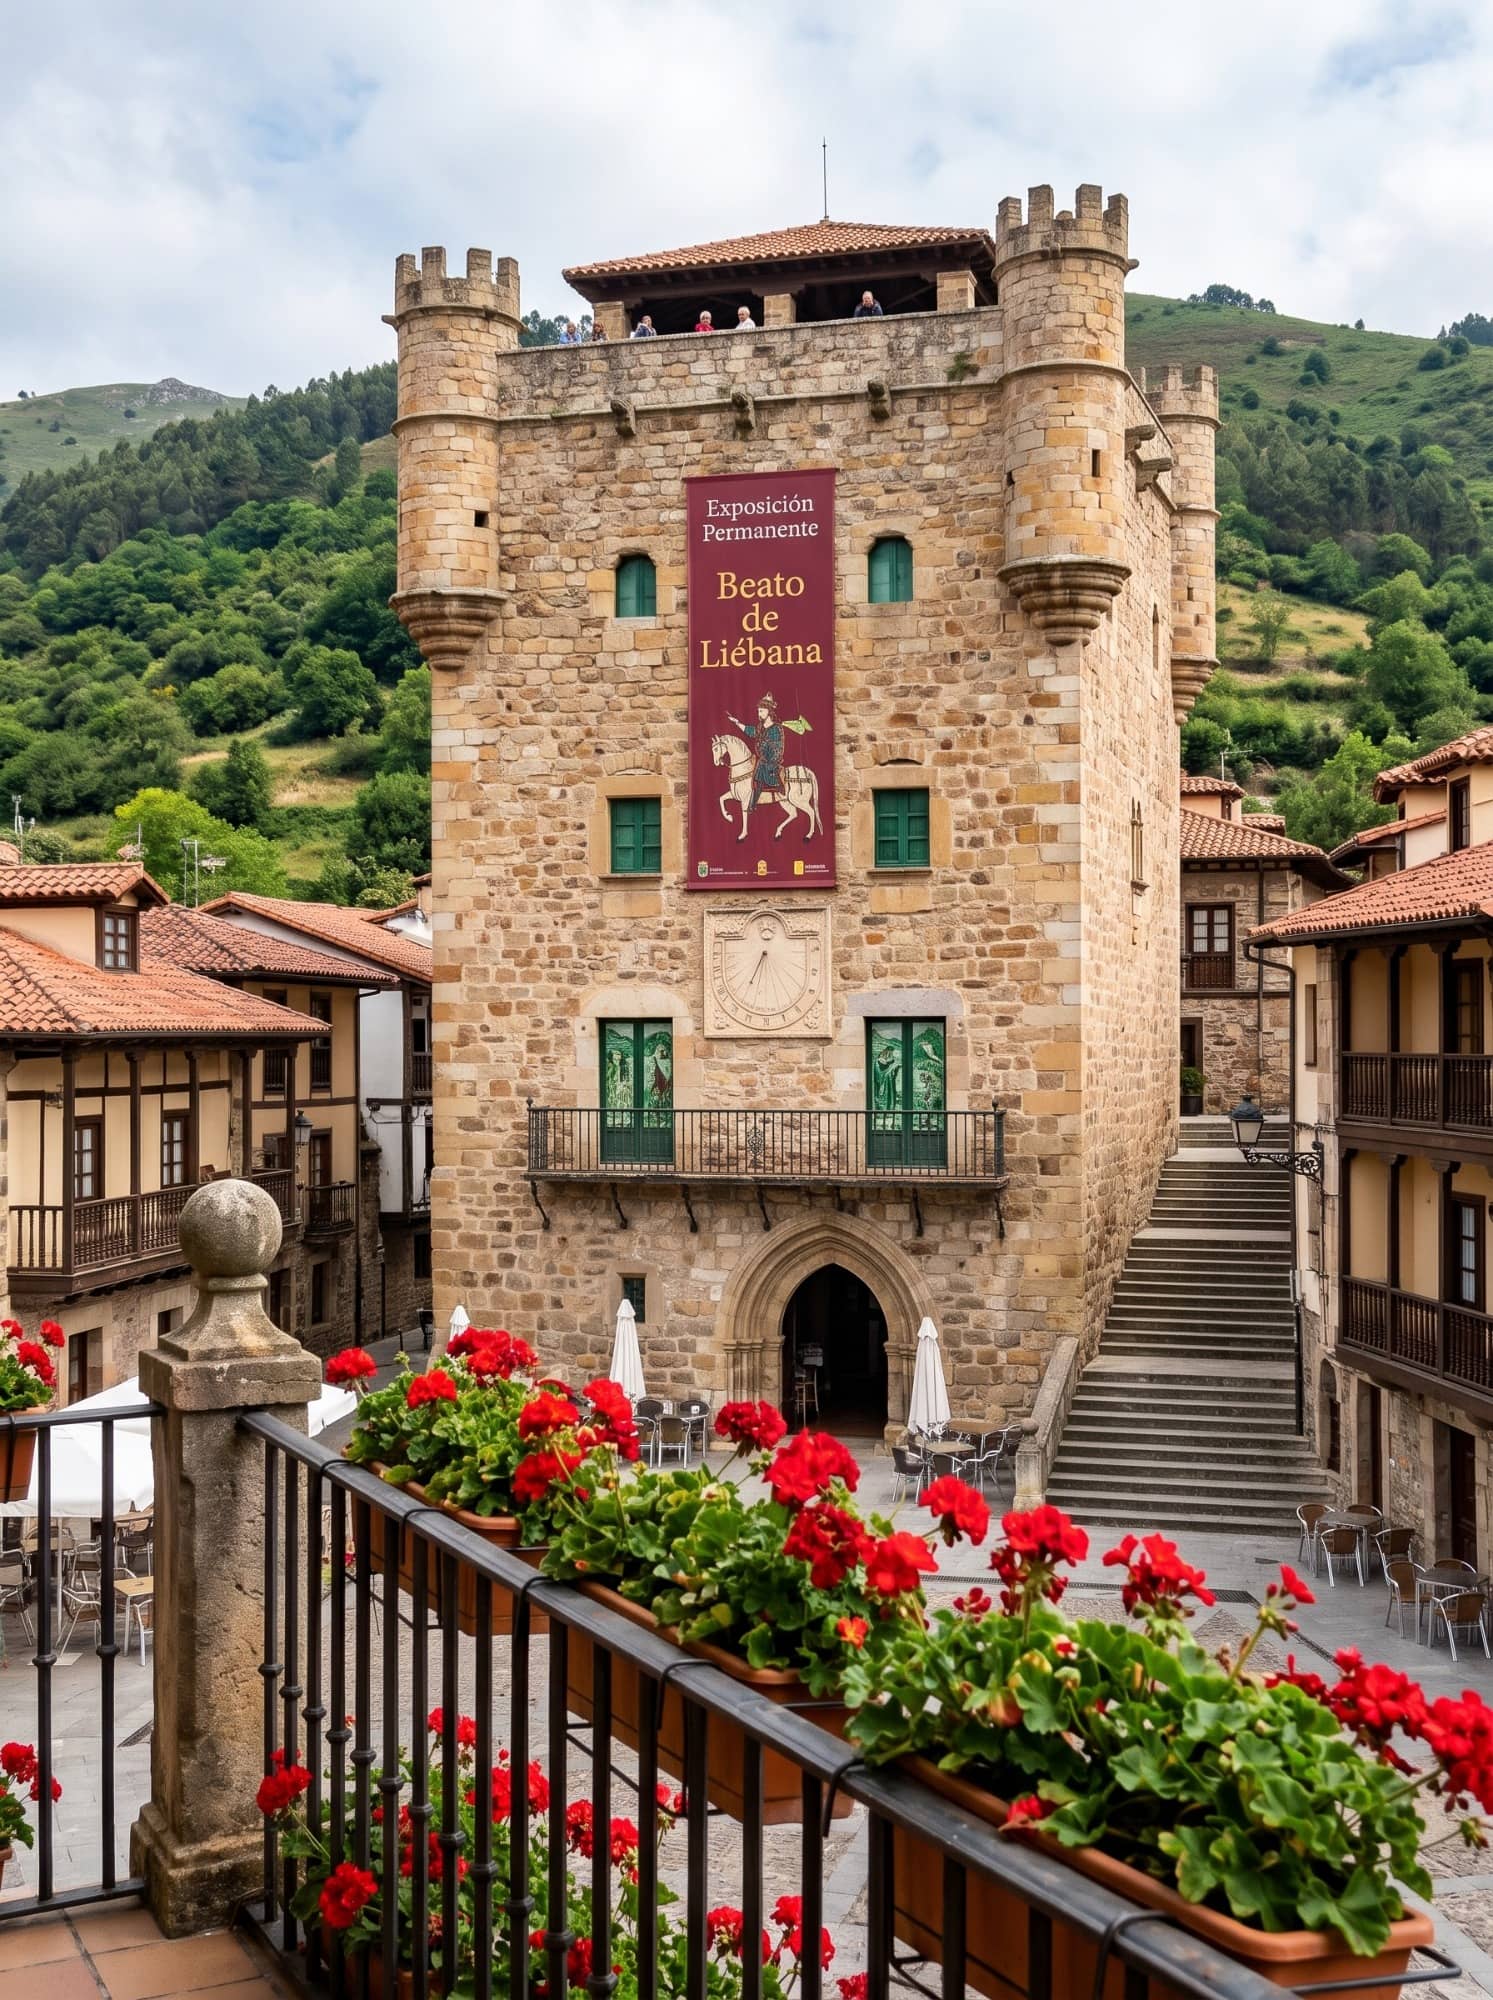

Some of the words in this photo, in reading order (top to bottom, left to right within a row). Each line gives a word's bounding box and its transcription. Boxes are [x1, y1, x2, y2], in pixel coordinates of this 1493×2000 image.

[706, 493, 814, 521] Exposición
[703, 521, 819, 542] Permanente
[717, 572, 805, 600] Beato
[742, 602, 779, 632] de
[700, 637, 823, 668] Liébana
